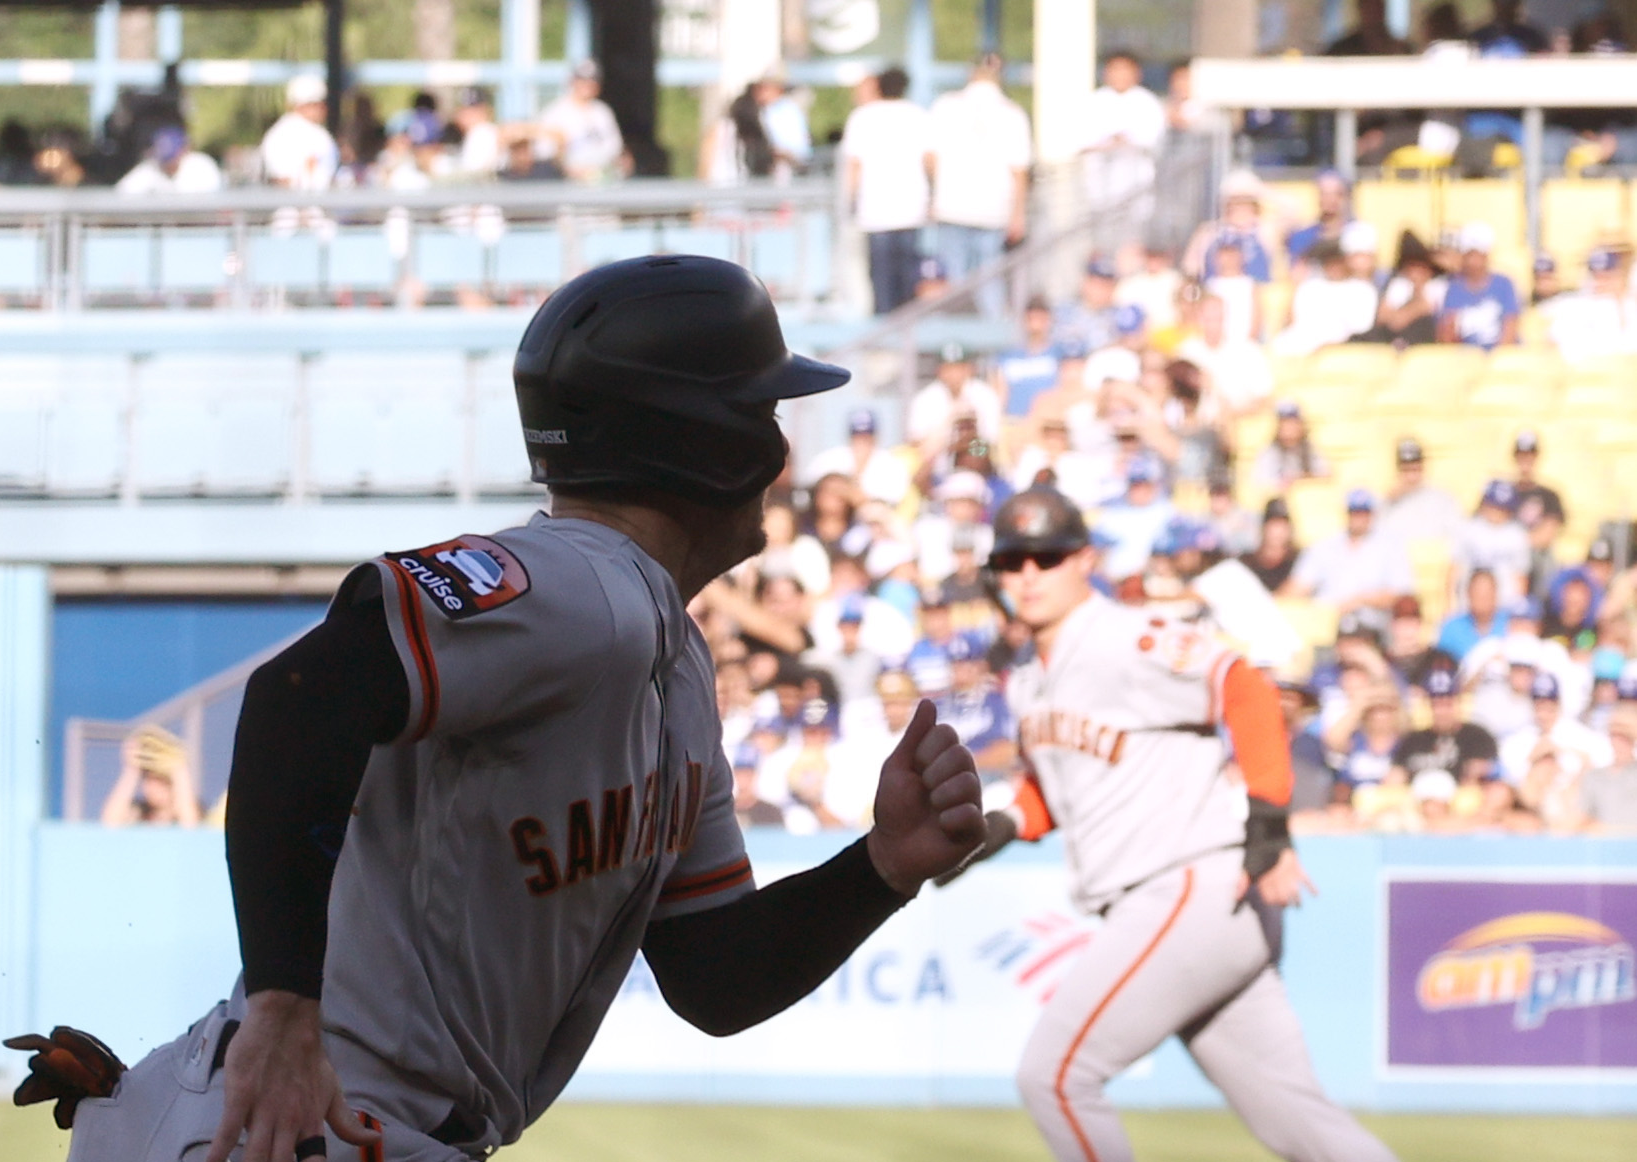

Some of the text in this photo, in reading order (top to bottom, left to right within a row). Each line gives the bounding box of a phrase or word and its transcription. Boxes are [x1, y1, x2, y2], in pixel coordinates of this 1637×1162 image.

[399, 557, 463, 611] cruise
[509, 782, 634, 898] SAN
[1417, 945, 1636, 1031] ampm
